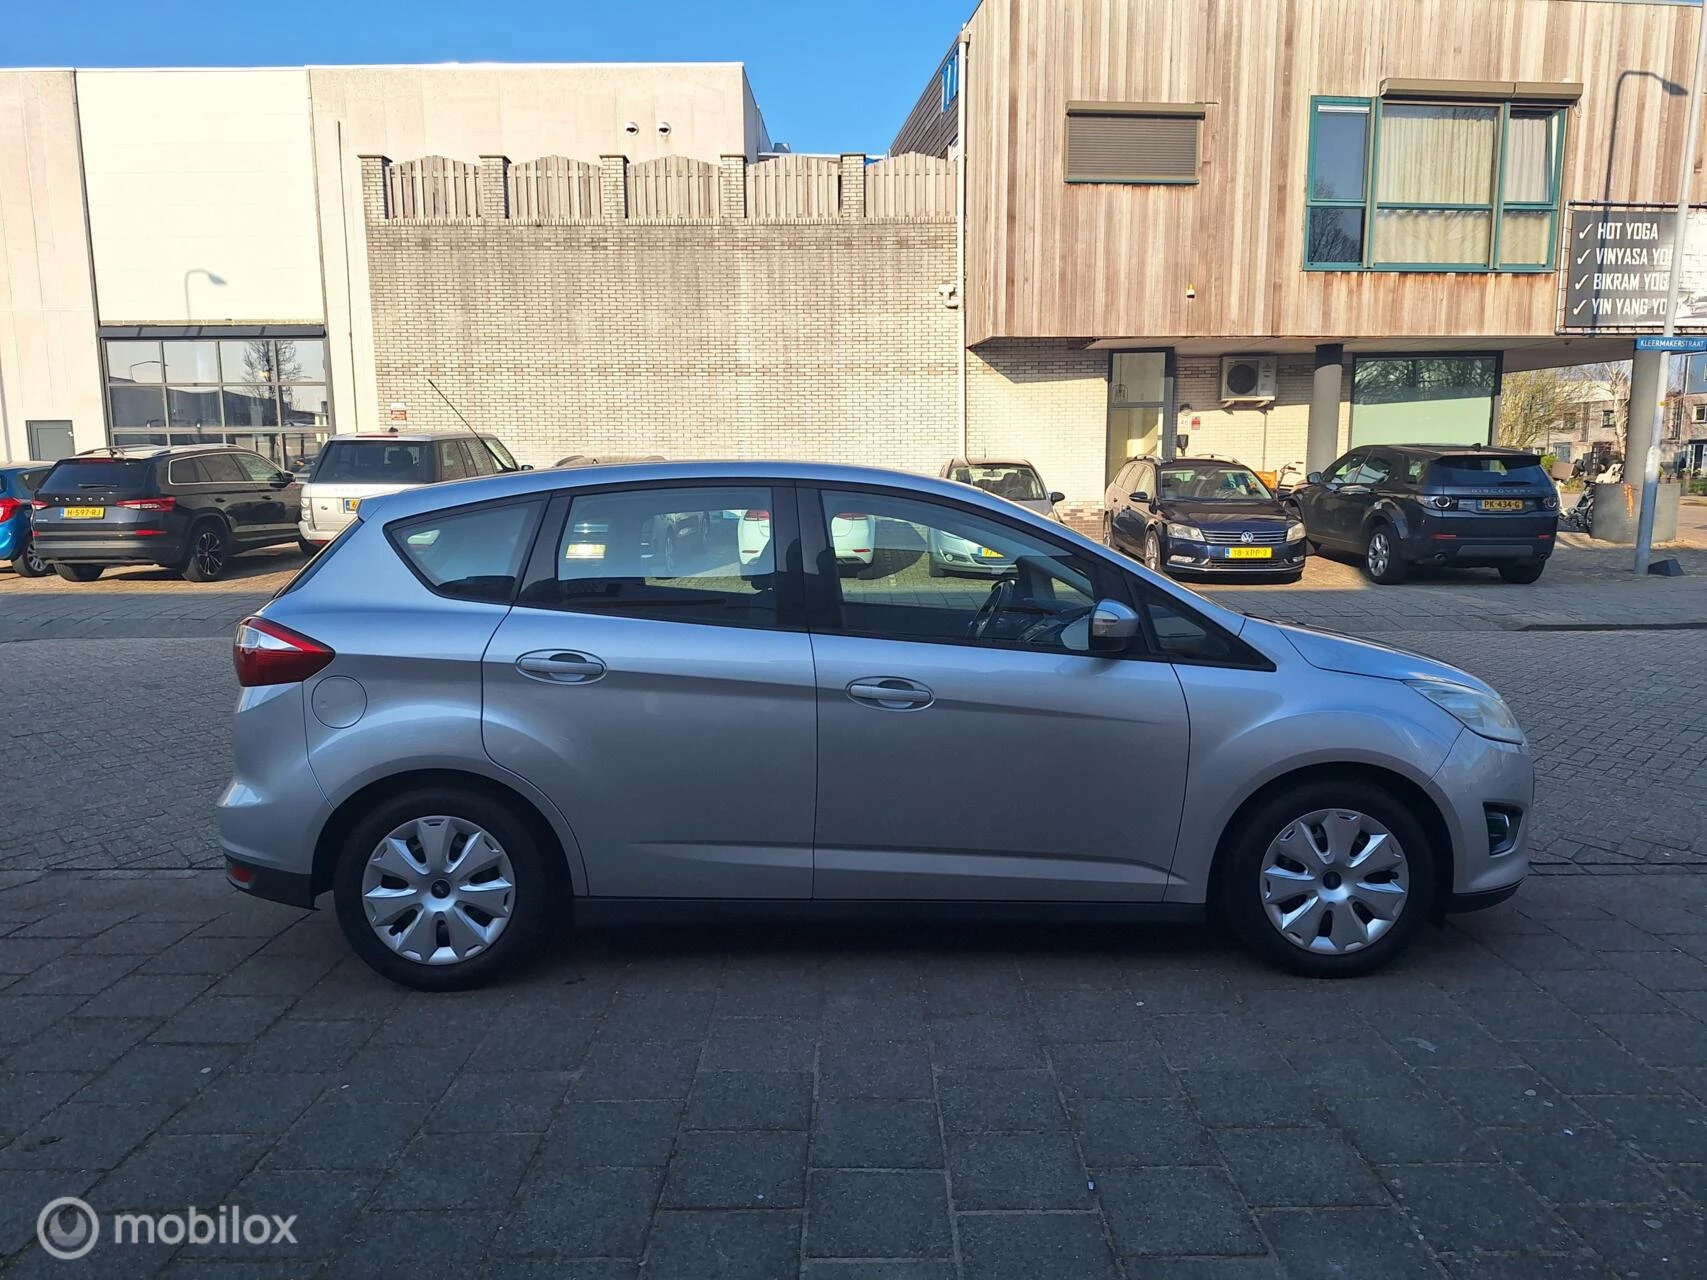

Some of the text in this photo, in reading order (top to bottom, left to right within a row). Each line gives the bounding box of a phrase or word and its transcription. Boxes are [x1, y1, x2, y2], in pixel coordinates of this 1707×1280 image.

[1597, 222, 1659, 240] HOT YOGA
[1595, 247, 1673, 265] VINYASA YO
[1593, 273, 1670, 291] BIKRAM YOG
[1591, 298, 1612, 315] YIN
[1616, 298, 1649, 315] YANG
[1640, 339, 1705, 347] KLEERMAKERSTRAAT
